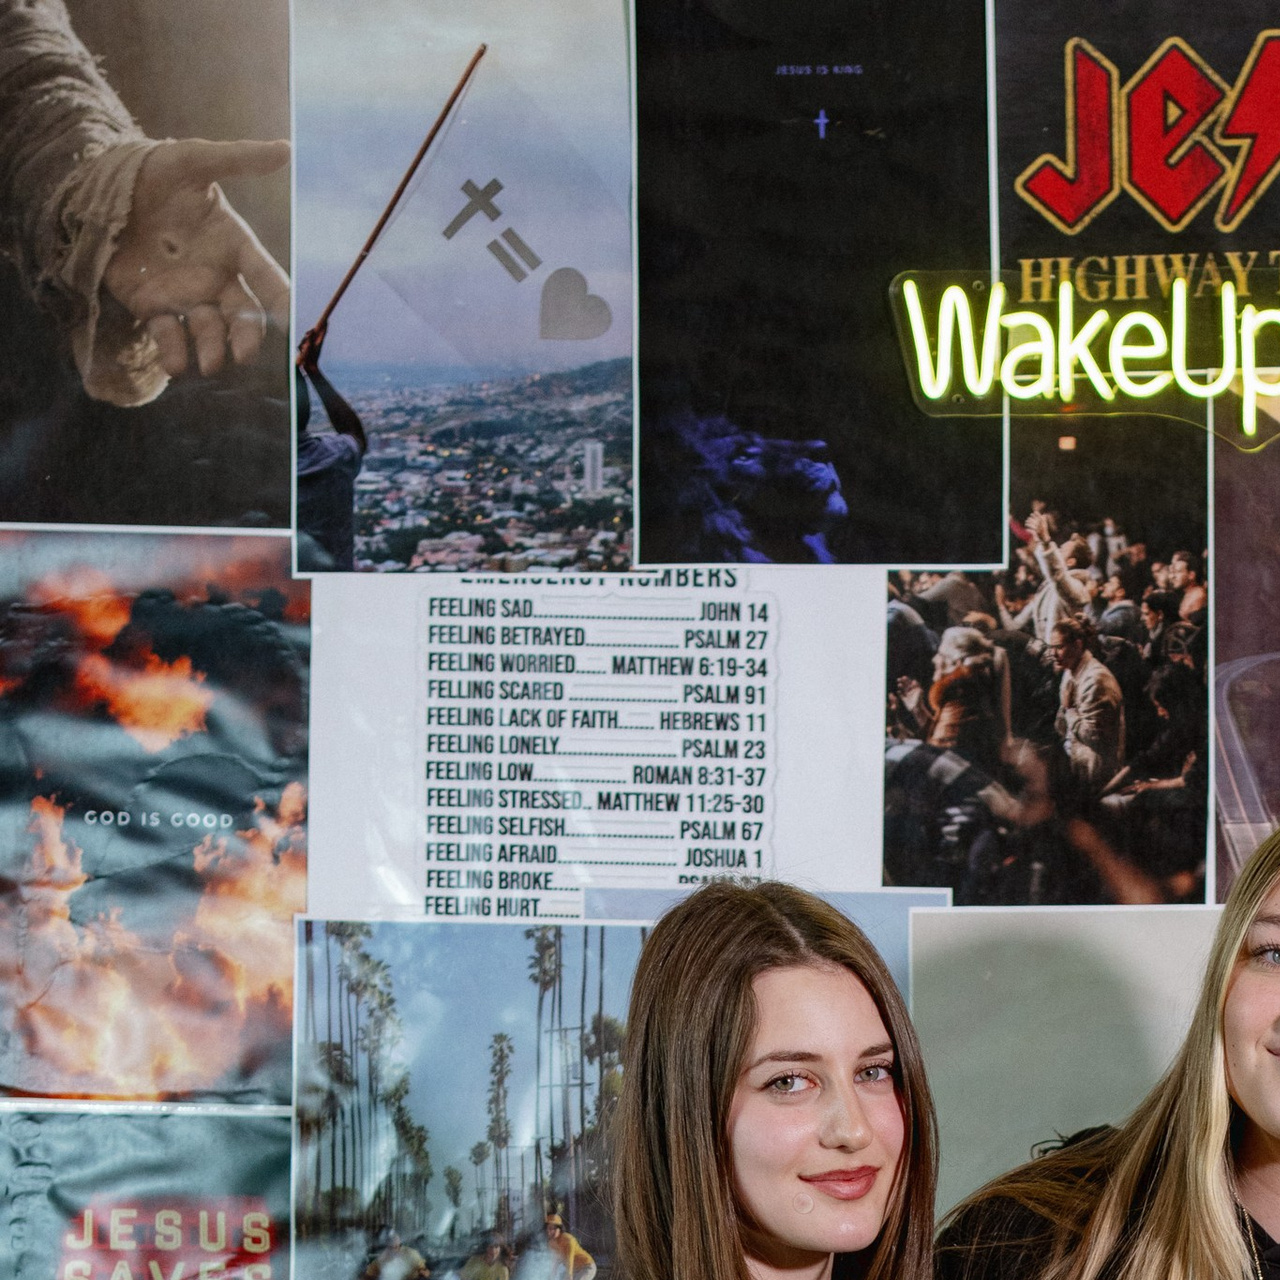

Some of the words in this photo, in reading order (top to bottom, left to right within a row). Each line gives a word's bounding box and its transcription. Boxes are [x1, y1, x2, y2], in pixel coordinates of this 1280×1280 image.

[776, 65, 812, 75] JESUS
[816, 65, 829, 75] IS
[1018, 251, 1254, 302] HIGHWAY
[429, 597, 496, 617] FEELING
[501, 599, 533, 618] SAD
[699, 602, 741, 621] JOHN
[748, 603, 769, 622] 14
[428, 625, 495, 644] FEELING
[501, 626, 585, 646] BETRAYED
[684, 630, 740, 649] PSALM
[746, 631, 768, 650] 27
[428, 652, 495, 672] FEELING
[500, 653, 575, 673] WORRIED
[612, 656, 694, 675] MATTHEW
[699, 657, 768, 677] 6:19-34
[428, 680, 494, 699] FELLING
[499, 681, 563, 700] SCARED
[683, 684, 739, 704] PSALM
[745, 685, 766, 704] 91
[427, 707, 494, 726] FEELING
[500, 708, 541, 727] LACK
[546, 709, 566, 728] OF
[572, 710, 618, 729] FAITH
[660, 711, 740, 731] HEBREWS
[746, 713, 766, 732] 11
[427, 734, 494, 753] FEELING
[499, 735, 560, 755] LONELY
[682, 739, 738, 758] PSALM
[744, 740, 766, 759] 23
[426, 761, 493, 780] FEELING
[498, 762, 534, 781] LOW
[633, 765, 693, 785] ROMAN
[698, 766, 766, 786] 8:31-37
[427, 788, 494, 807] FEELING
[499, 789, 582, 810] STRESSED
[598, 792, 680, 811] MATTHEW
[686, 793, 764, 813] 11:25-30
[84, 810, 131, 826] GOD
[141, 811, 161, 828] IS
[170, 812, 234, 829] GOOD
[427, 815, 493, 835] FEELING
[498, 816, 565, 836] SELFISH
[680, 821, 736, 840] PSALM
[741, 822, 763, 841] 67
[426, 842, 493, 862] FEELING
[498, 843, 557, 863] AFRAID
[684, 848, 747, 868] JOSHUA
[754, 849, 762, 868] 1
[427, 869, 493, 889] FEELING
[498, 871, 554, 890] BROKE
[425, 896, 491, 916] FEELING
[497, 897, 540, 917] HURT
[65, 1209, 271, 1254] JESUS
